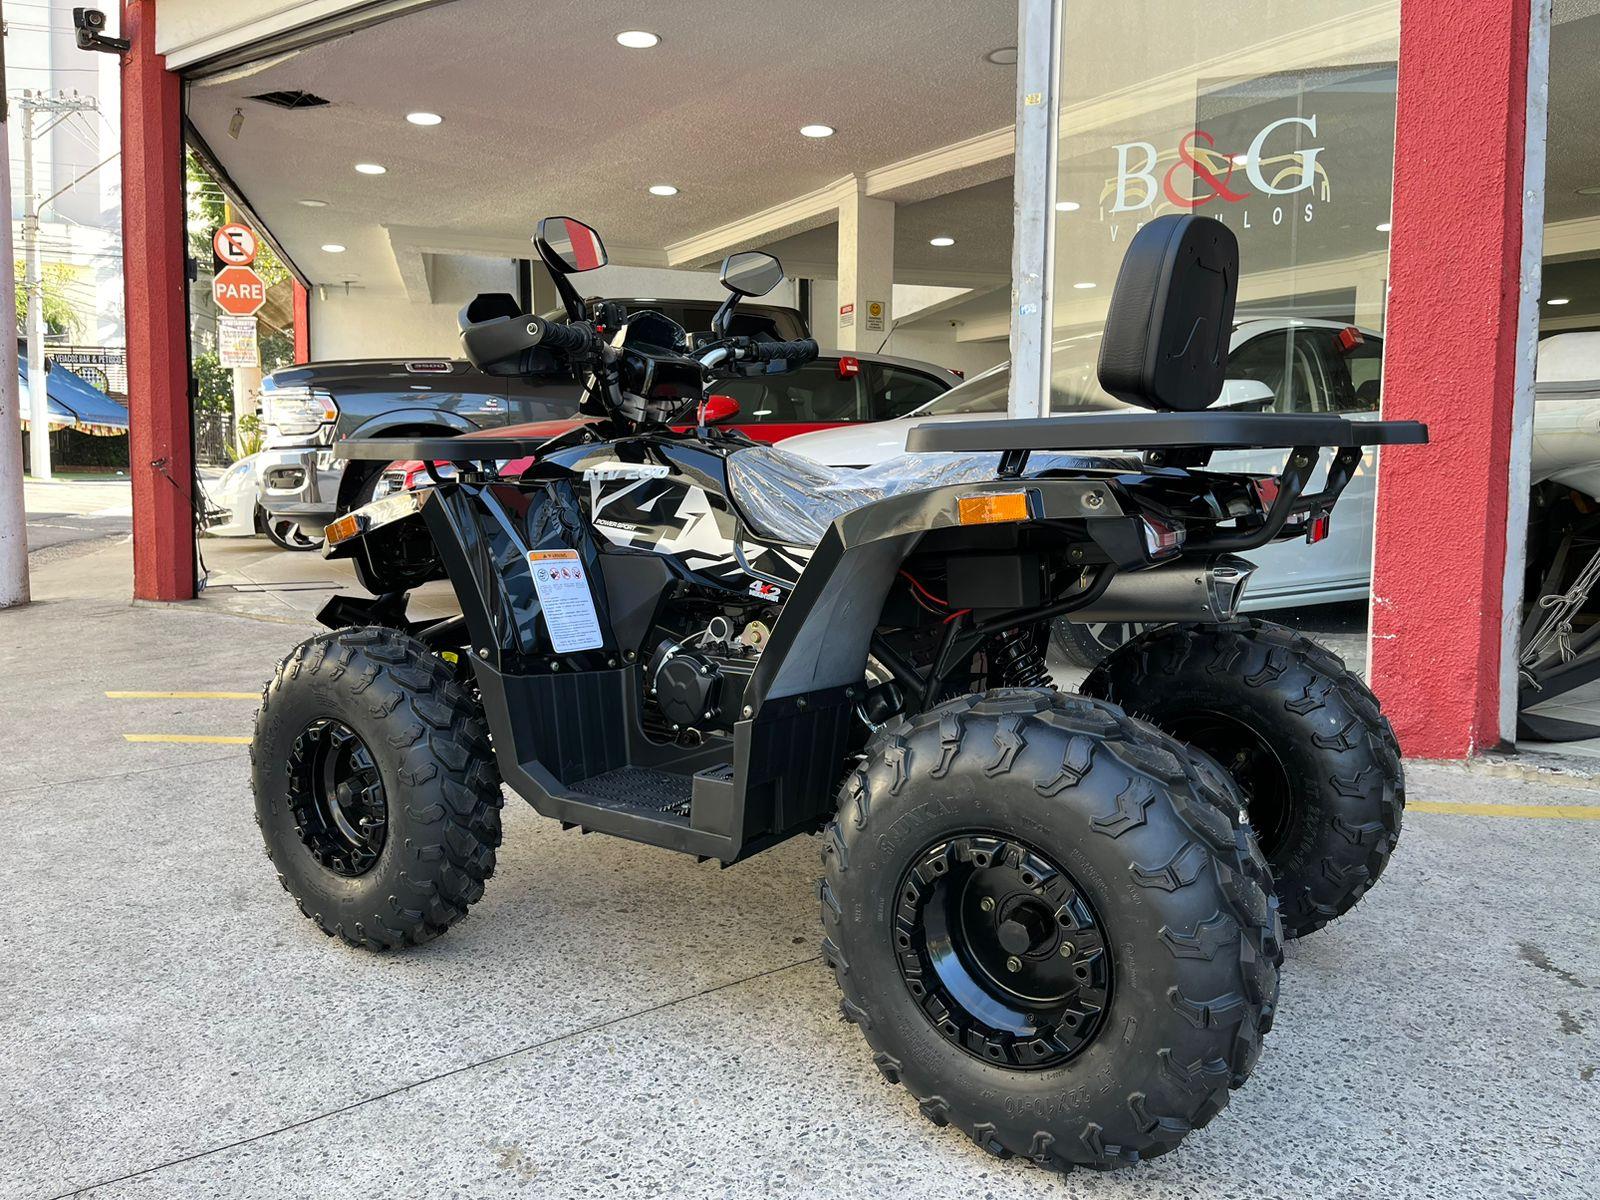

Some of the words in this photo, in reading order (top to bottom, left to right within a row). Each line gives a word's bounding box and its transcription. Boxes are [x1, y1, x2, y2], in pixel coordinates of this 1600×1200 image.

[1109, 114, 1325, 214] B&G
[1110, 203, 1313, 242] VLOS
[228, 232, 243, 256] E
[216, 283, 262, 299] PARE
[79, 355, 90, 363] BAR
[582, 468, 621, 482] ATV
[595, 518, 618, 528] POWER
[616, 521, 638, 531] SPORT
